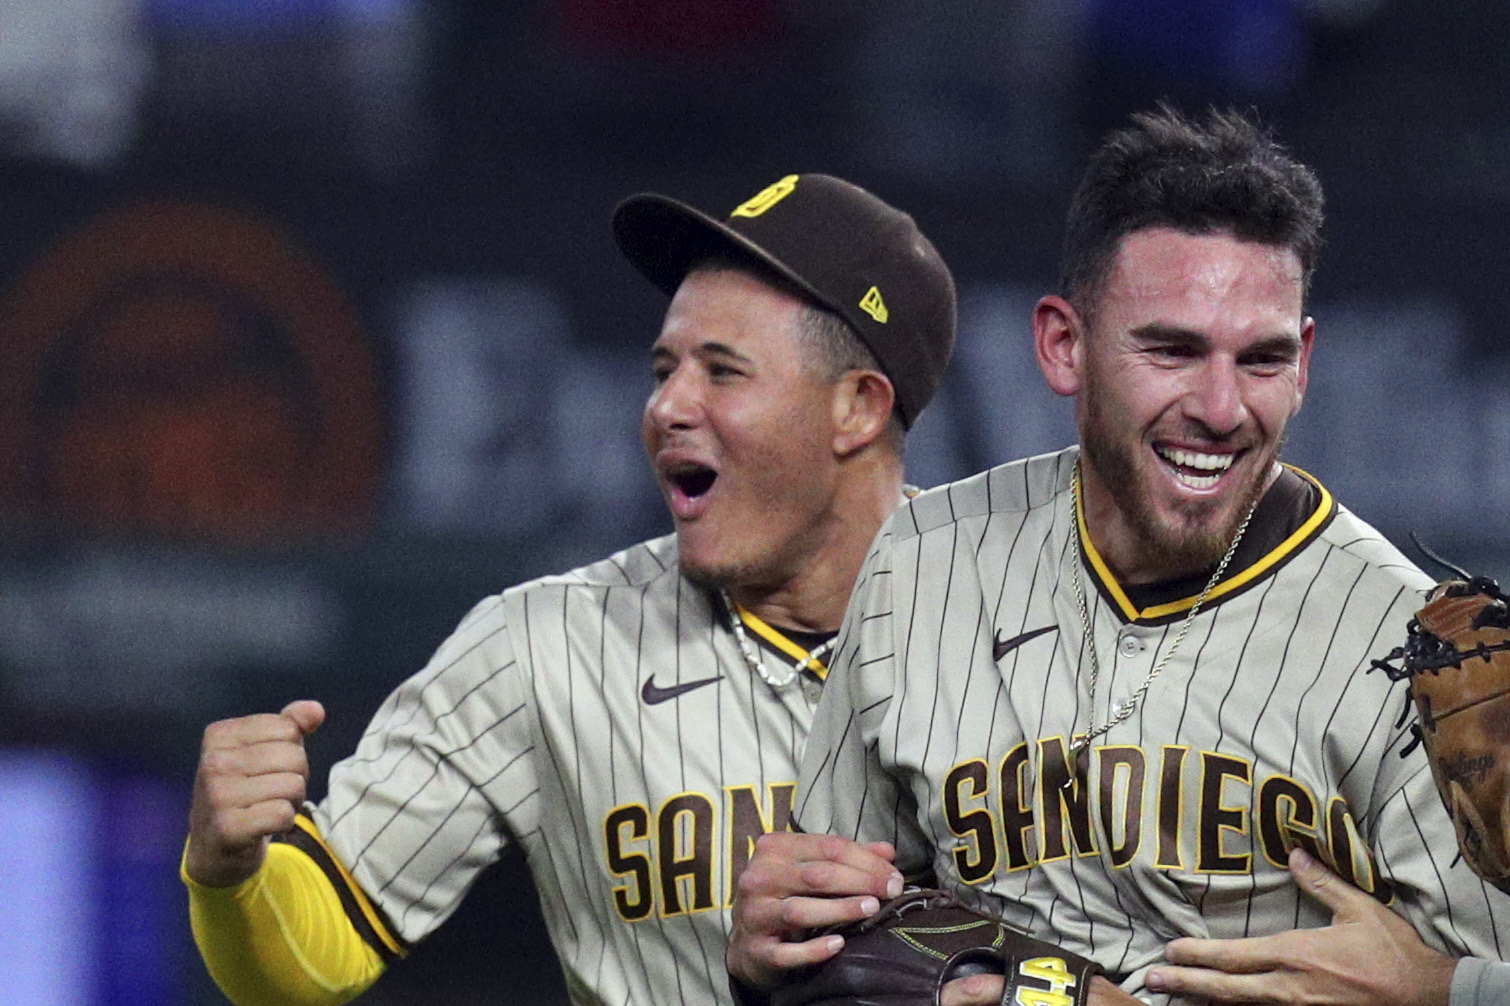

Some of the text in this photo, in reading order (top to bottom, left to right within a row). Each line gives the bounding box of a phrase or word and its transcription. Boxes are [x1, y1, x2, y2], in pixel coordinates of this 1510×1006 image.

[604, 781, 799, 922] SAN
[943, 733, 1395, 907] SAN DIEGO
